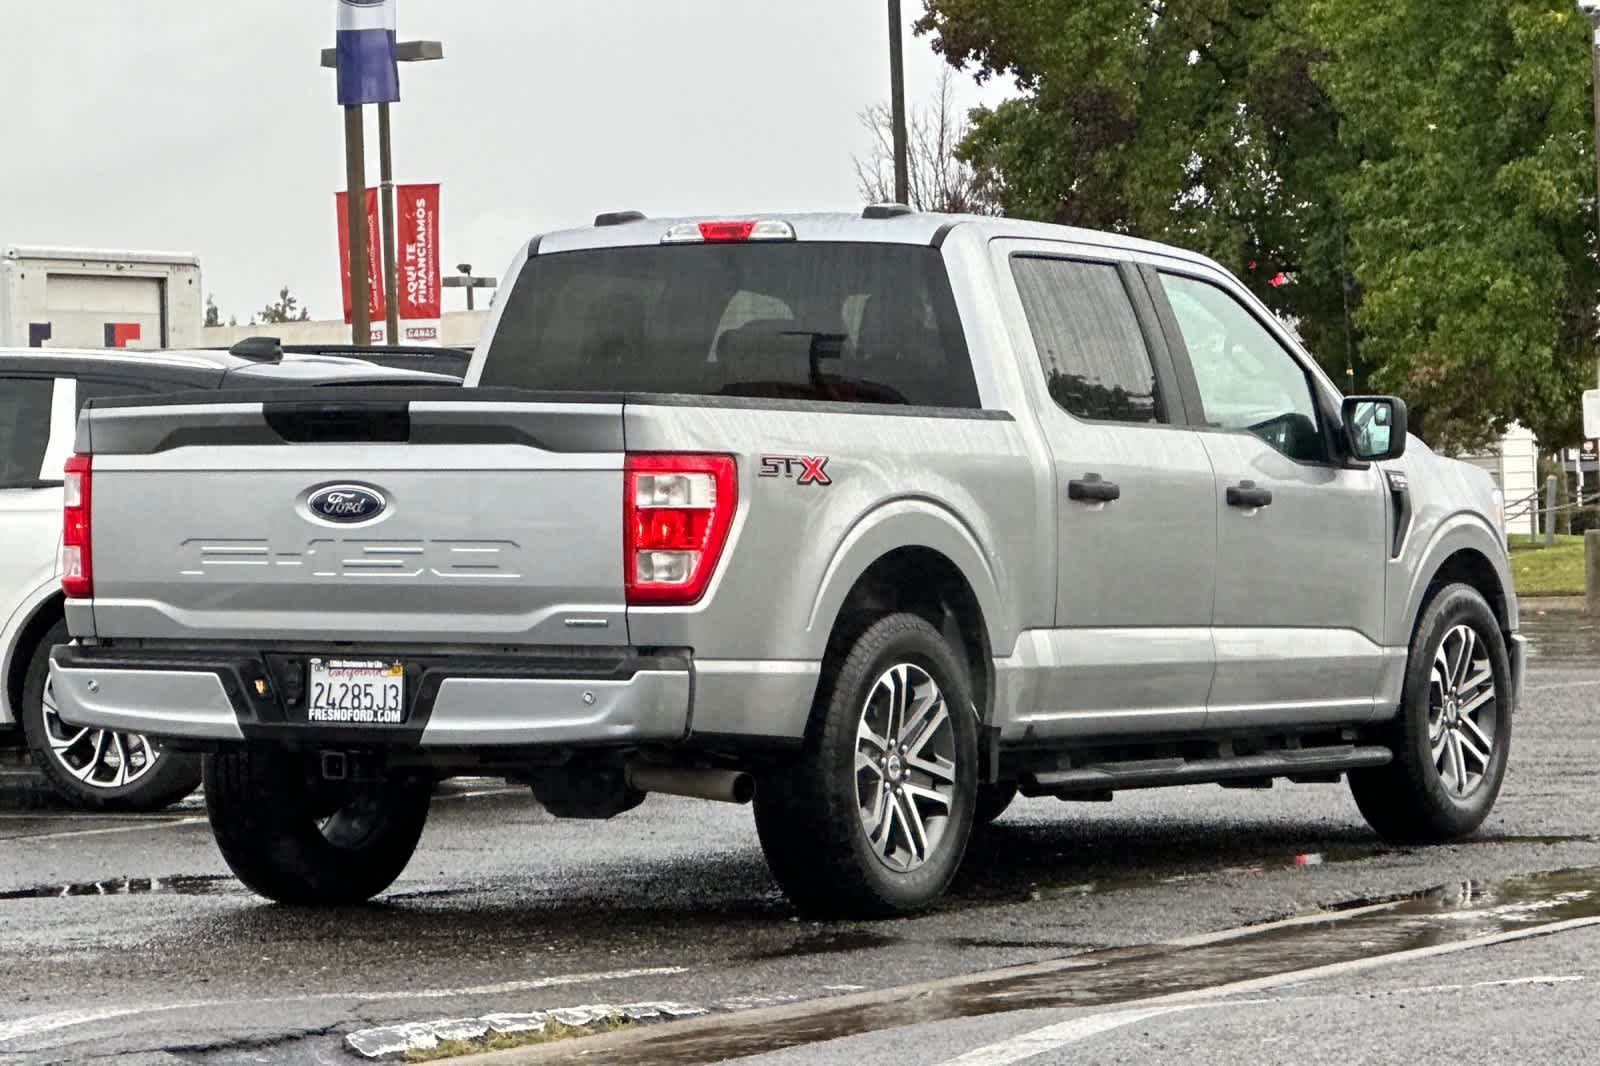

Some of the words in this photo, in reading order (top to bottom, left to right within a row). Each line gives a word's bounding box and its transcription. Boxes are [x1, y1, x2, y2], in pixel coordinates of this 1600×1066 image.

[406, 244, 416, 262] TE
[416, 198, 427, 304] FINANCIAMOS
[407, 329, 435, 338] GANAS
[758, 455, 832, 485] STX
[324, 492, 366, 513] Ford
[180, 538, 521, 577] F-150
[314, 682, 400, 711] 24285J3
[308, 708, 401, 723] FRESNOFORD.COM
